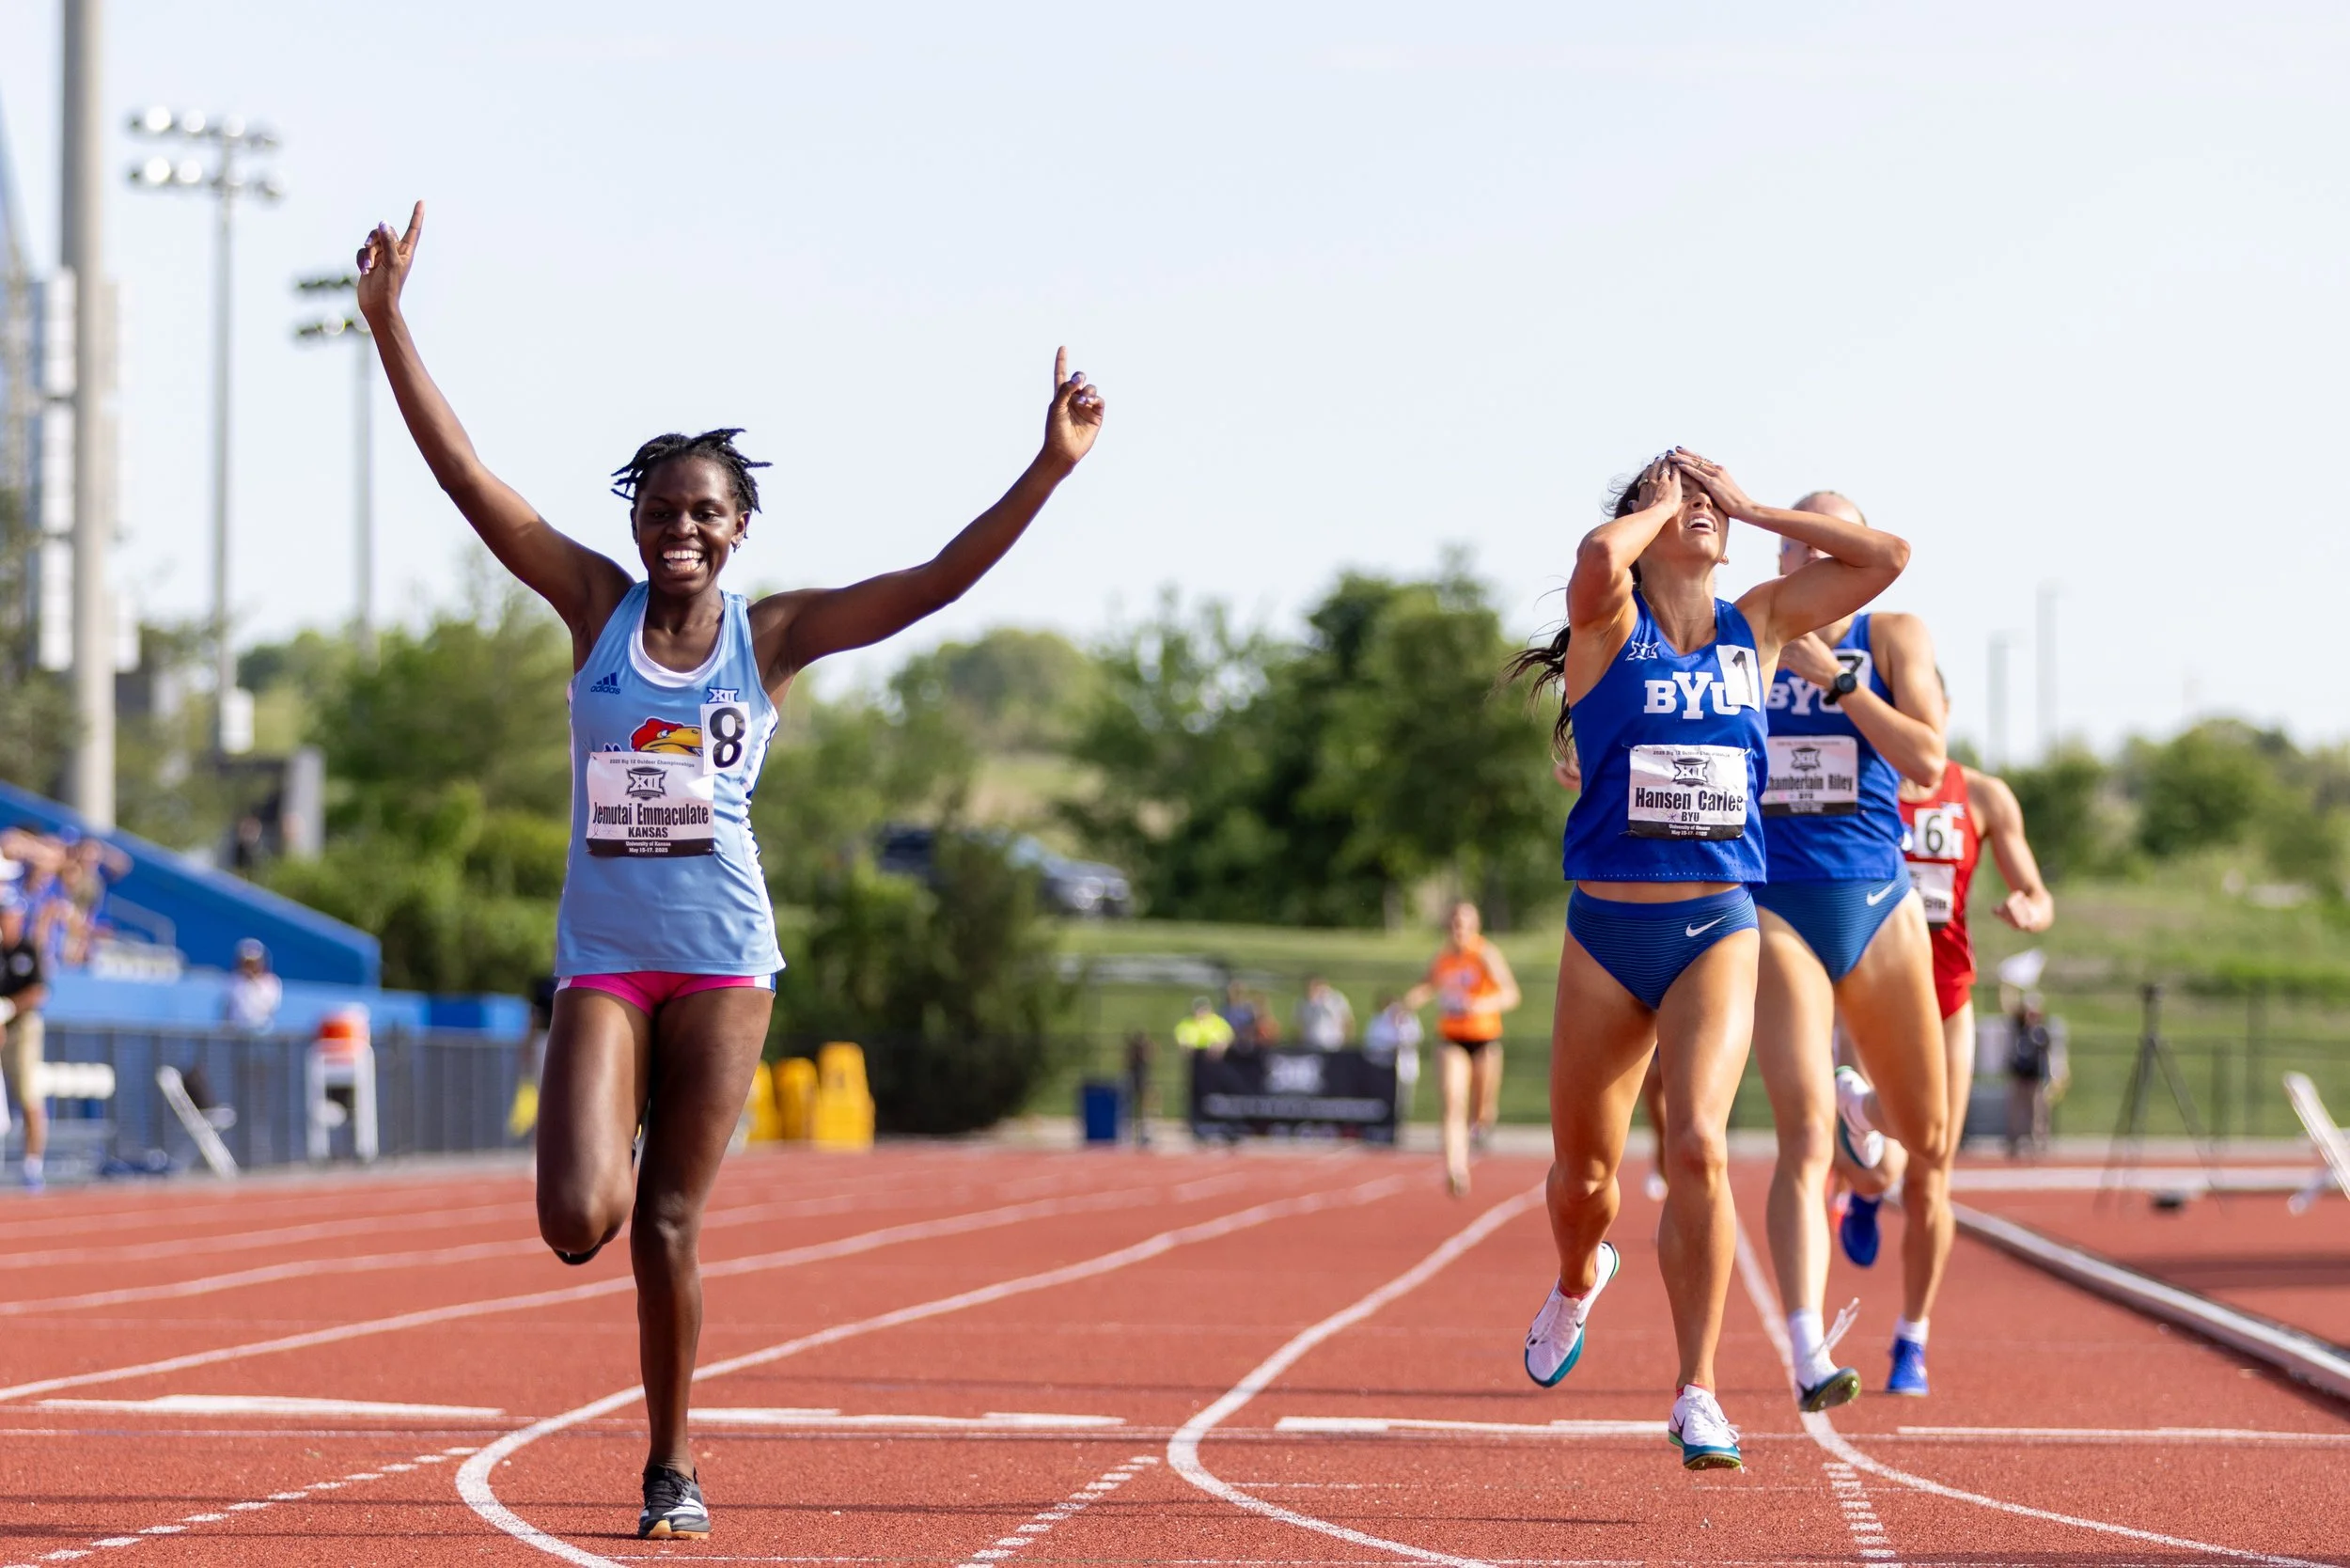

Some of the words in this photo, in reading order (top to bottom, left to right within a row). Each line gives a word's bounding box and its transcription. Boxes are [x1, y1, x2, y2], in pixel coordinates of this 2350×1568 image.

[1731, 650, 1753, 704] 1
[590, 684, 621, 695] adidas
[1643, 671, 1742, 720] BYU
[710, 706, 746, 769] 8
[626, 770, 667, 795] XII
[1828, 774, 1853, 792] Riley
[1635, 787, 1692, 810] Hansen
[1699, 789, 1744, 811] Carlee
[593, 802, 633, 825] Jemutai
[637, 803, 710, 826] Emmaculate
[1681, 811, 1700, 823] BYU
[628, 826, 669, 839] KANSAS
[1925, 815, 1944, 854] 6
